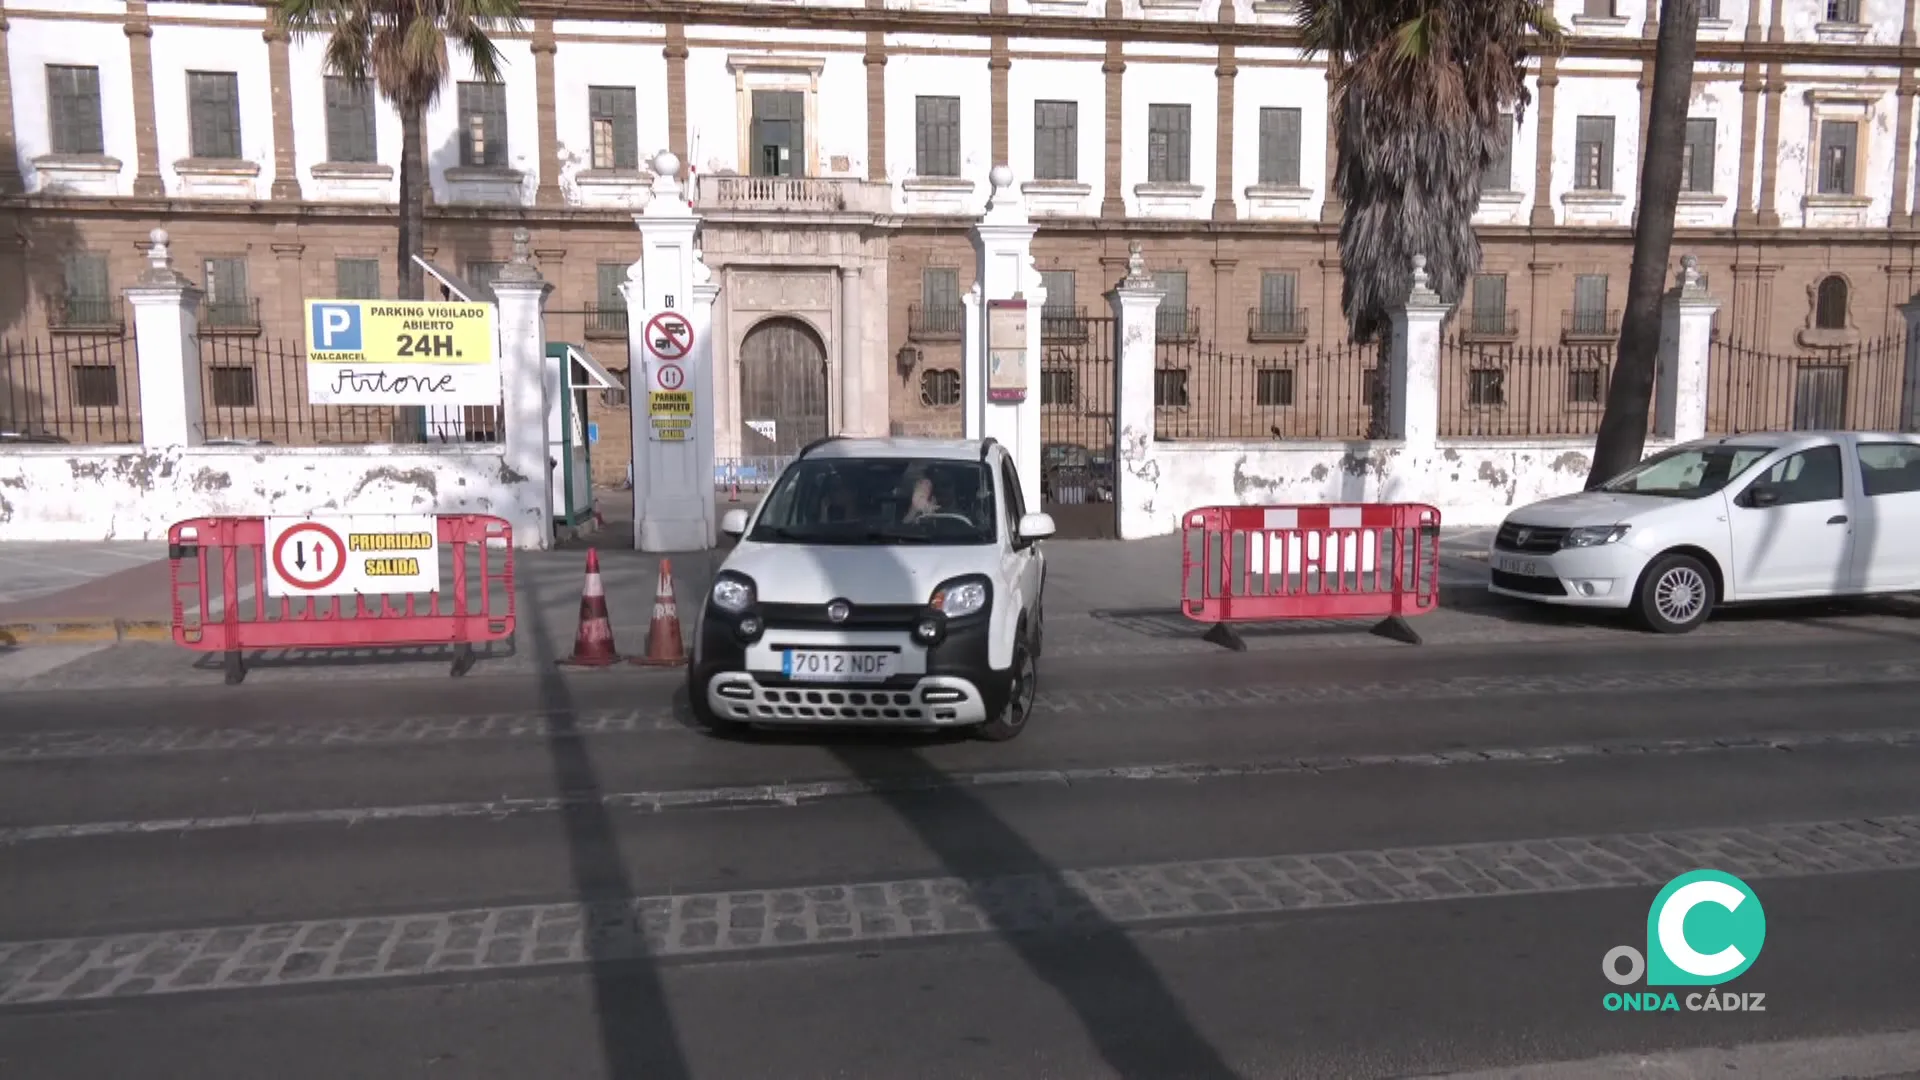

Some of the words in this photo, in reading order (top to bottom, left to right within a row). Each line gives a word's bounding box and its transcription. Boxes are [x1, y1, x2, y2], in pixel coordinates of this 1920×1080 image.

[371, 307, 424, 317] PARKING
[428, 308, 484, 318] VIGILADO
[321, 307, 351, 347] P
[403, 320, 454, 330] ABIERTO
[396, 334, 463, 357] 24H.
[310, 352, 367, 362] VALCARCEL
[655, 393, 687, 402] PARKING
[652, 403, 690, 412] COMPLETO
[349, 532, 432, 551] PRIORIDAD
[365, 558, 420, 576] SALIDA
[795, 654, 845, 673] 7012
[851, 654, 888, 673] NDF
